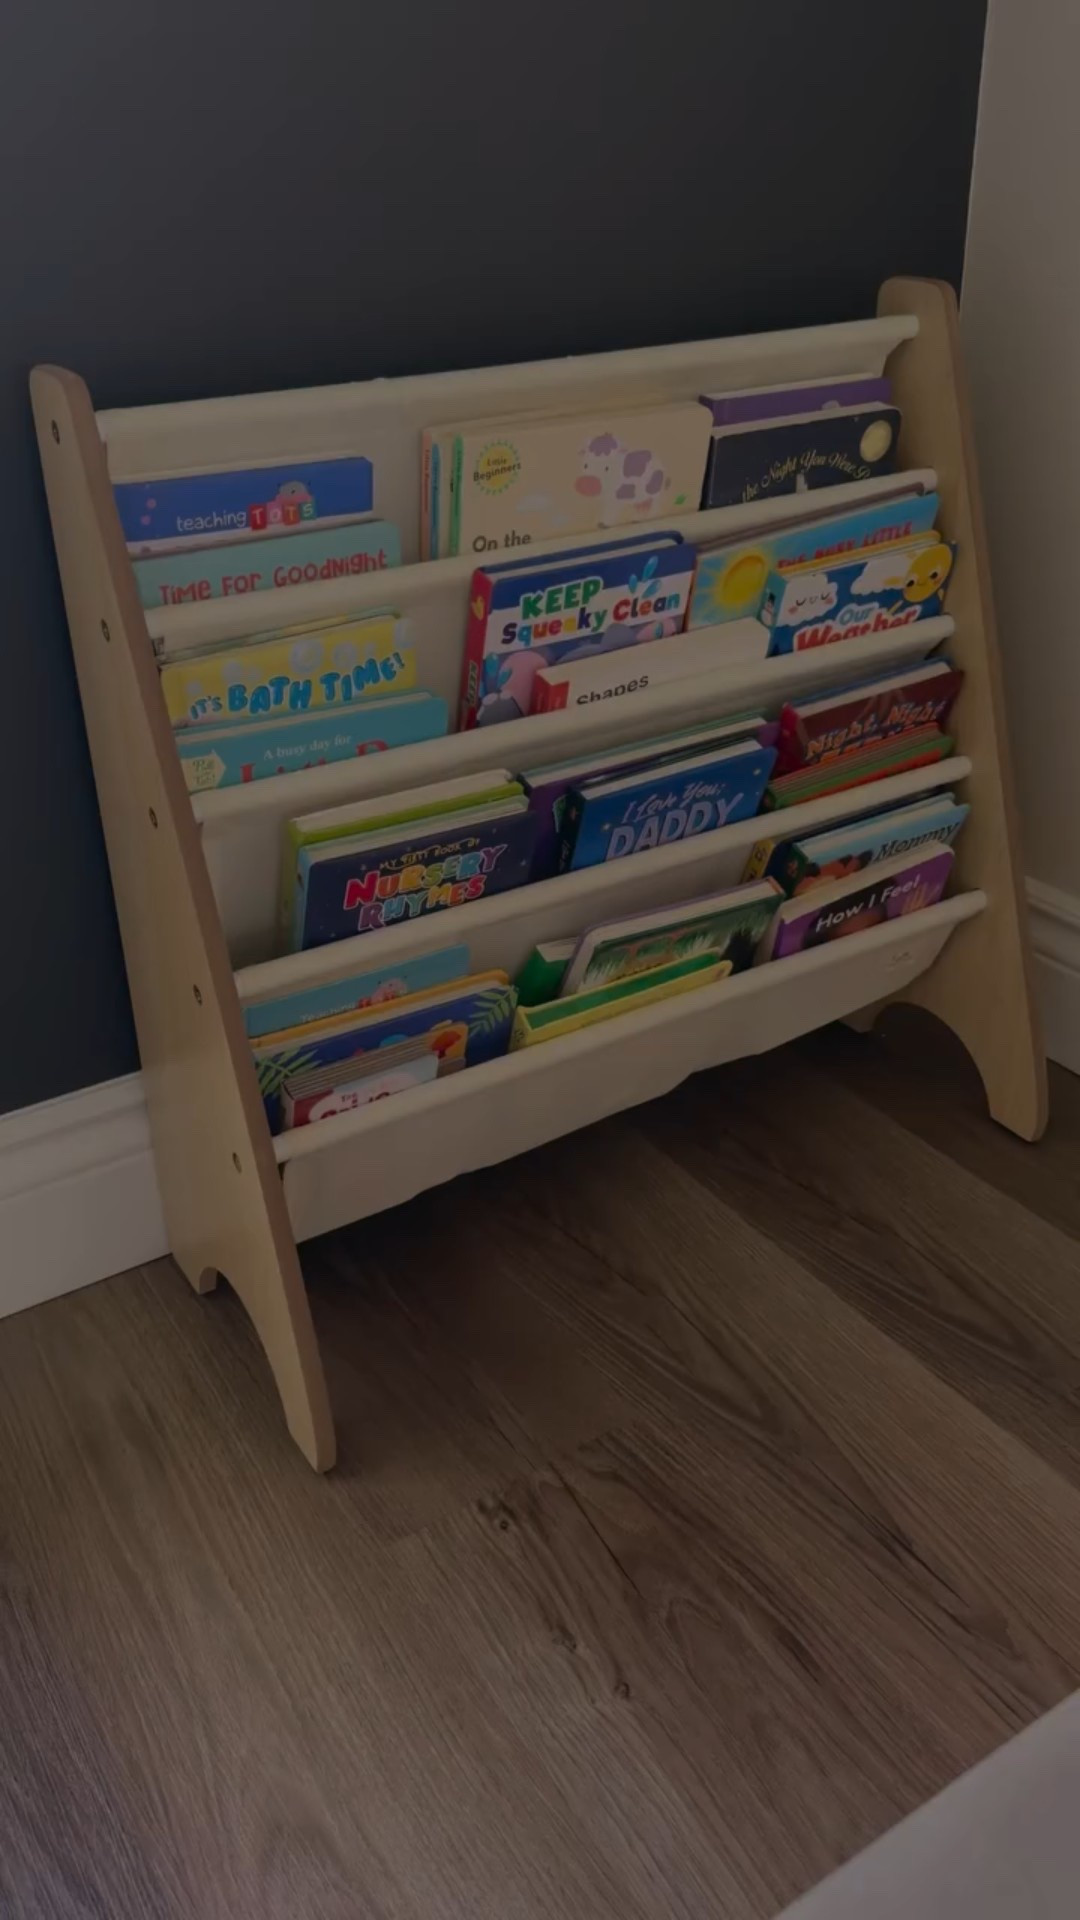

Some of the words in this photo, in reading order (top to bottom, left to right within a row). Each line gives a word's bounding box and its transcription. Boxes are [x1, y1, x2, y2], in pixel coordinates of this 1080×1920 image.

[473, 462, 521, 481] Beginners
[487, 456, 507, 467] Little
[761, 457, 797, 488] Night
[800, 449, 827, 469] You
[828, 452, 855, 473] Were
[176, 509, 247, 532] teaching
[252, 503, 315, 527] TOTS
[472, 535, 498, 552] On
[504, 530, 531, 548] the
[501, 606, 608, 646] Squeaky
[612, 591, 680, 622] Clean
[521, 577, 602, 621] KEEP
[840, 607, 872, 625] Our
[227, 675, 313, 715] BATH
[320, 651, 406, 701] TIME!
[263, 749, 275, 760] A
[276, 742, 306, 761] busy
[309, 738, 331, 755] day
[334, 734, 352, 747] for
[604, 792, 744, 862] DADDY
[621, 800, 638, 823] I
[633, 793, 677, 822] Love
[874, 822, 960, 862] Mommy
[342, 843, 508, 911] NURSERY
[357, 873, 487, 931] RHYMES
[815, 901, 864, 932] How
[868, 893, 876, 909] I
[880, 874, 921, 903] Feel
